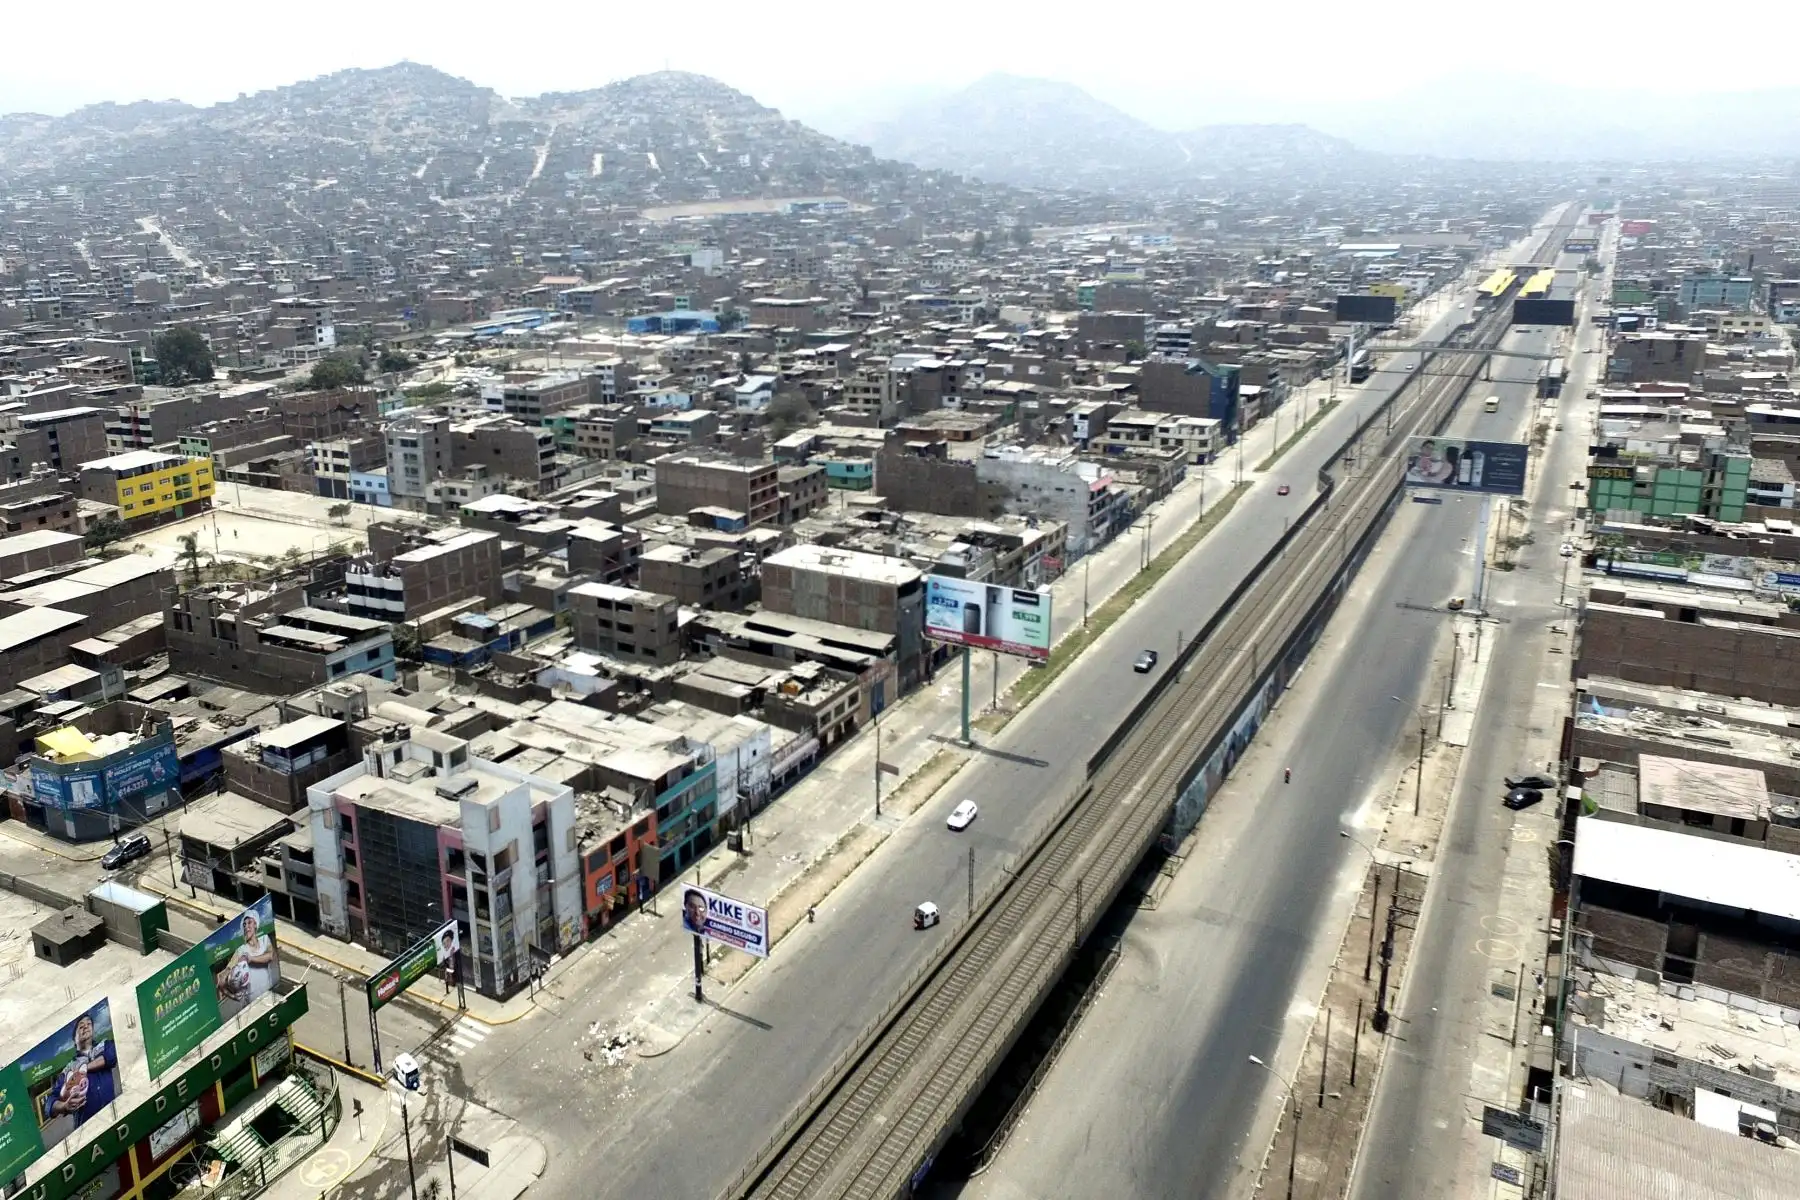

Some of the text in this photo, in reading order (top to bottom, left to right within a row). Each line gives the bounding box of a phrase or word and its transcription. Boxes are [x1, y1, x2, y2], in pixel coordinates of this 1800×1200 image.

[1587, 467, 1632, 479] HOSTAL
[709, 897, 742, 921] KIKE
[709, 920, 733, 934] CAMBIO
[734, 929, 758, 943] SEGURO
[155, 1078, 189, 1113] DE
[210, 1012, 280, 1072] DIOS
